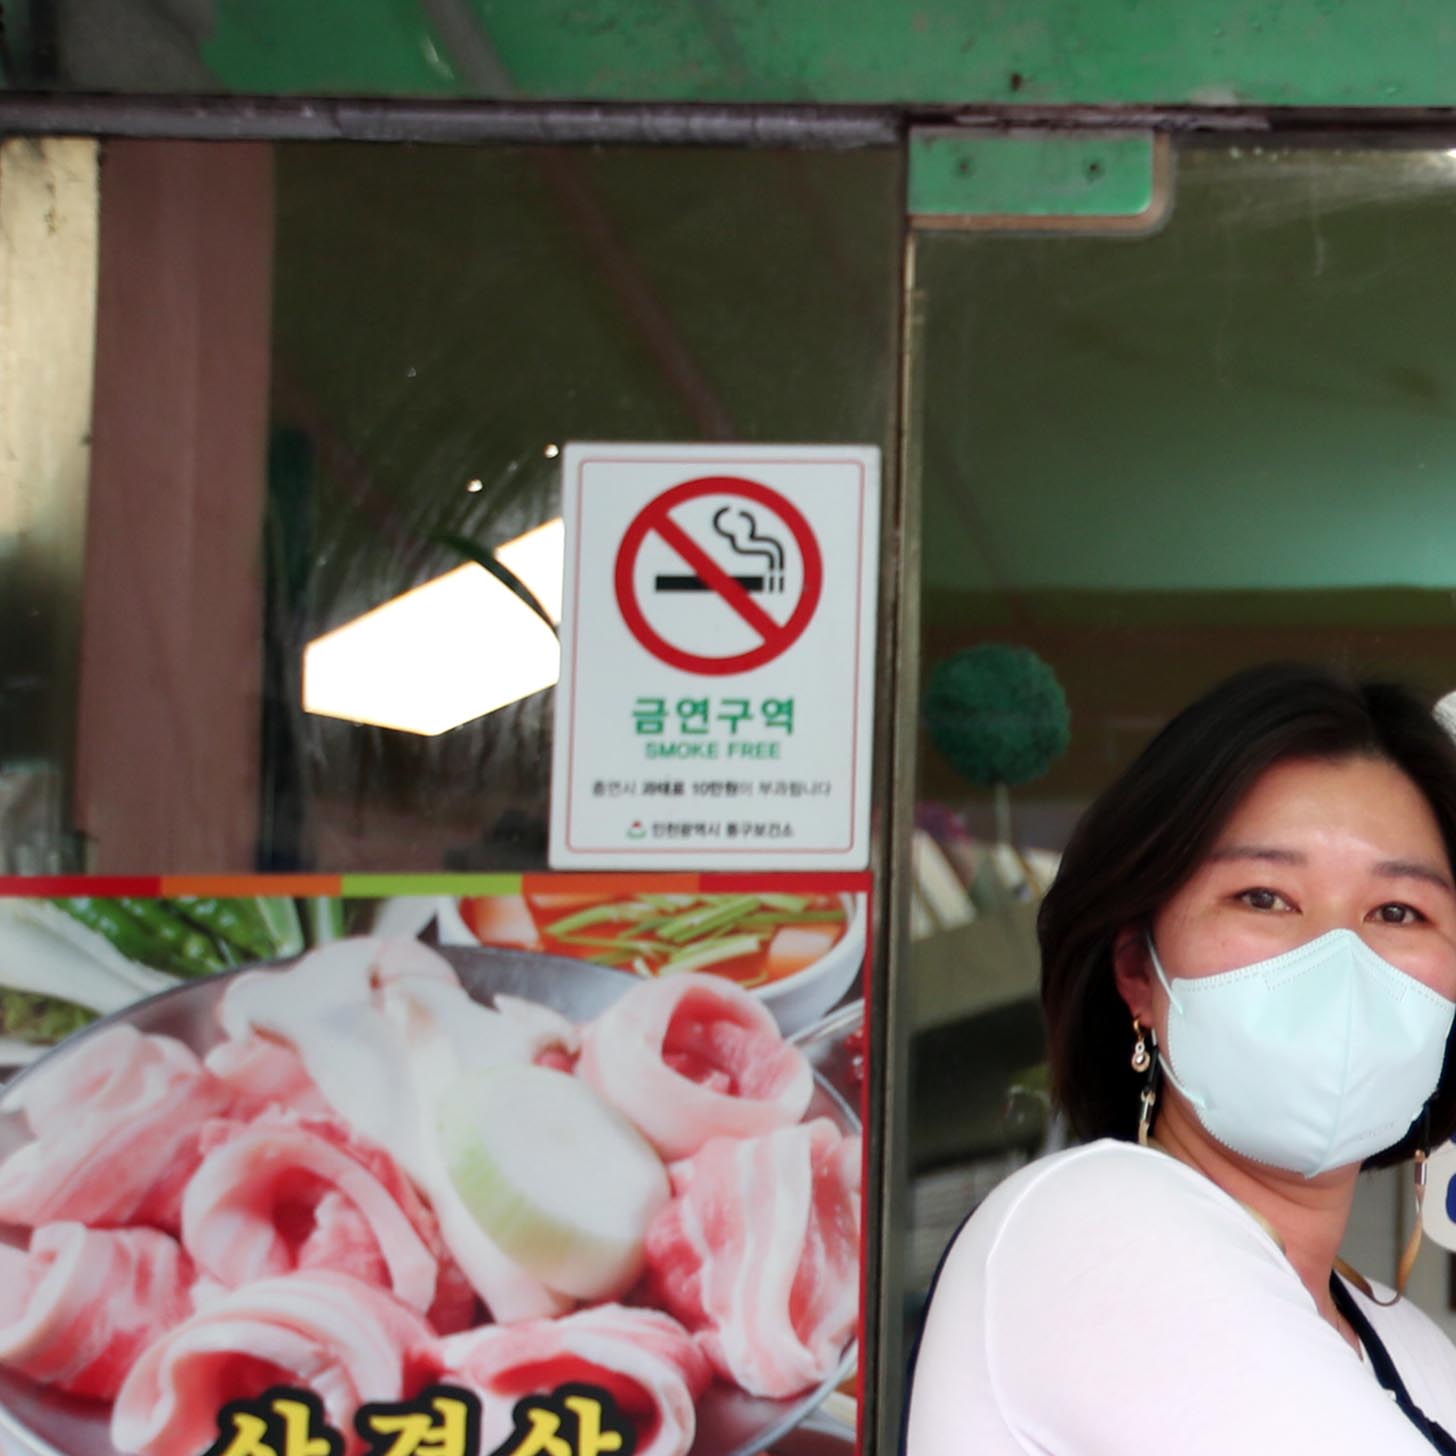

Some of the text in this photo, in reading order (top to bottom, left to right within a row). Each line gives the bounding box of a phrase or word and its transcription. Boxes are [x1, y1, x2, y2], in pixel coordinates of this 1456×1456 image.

[633, 697, 794, 735] 금연구역
[645, 740, 780, 759] SMOKE FREE
